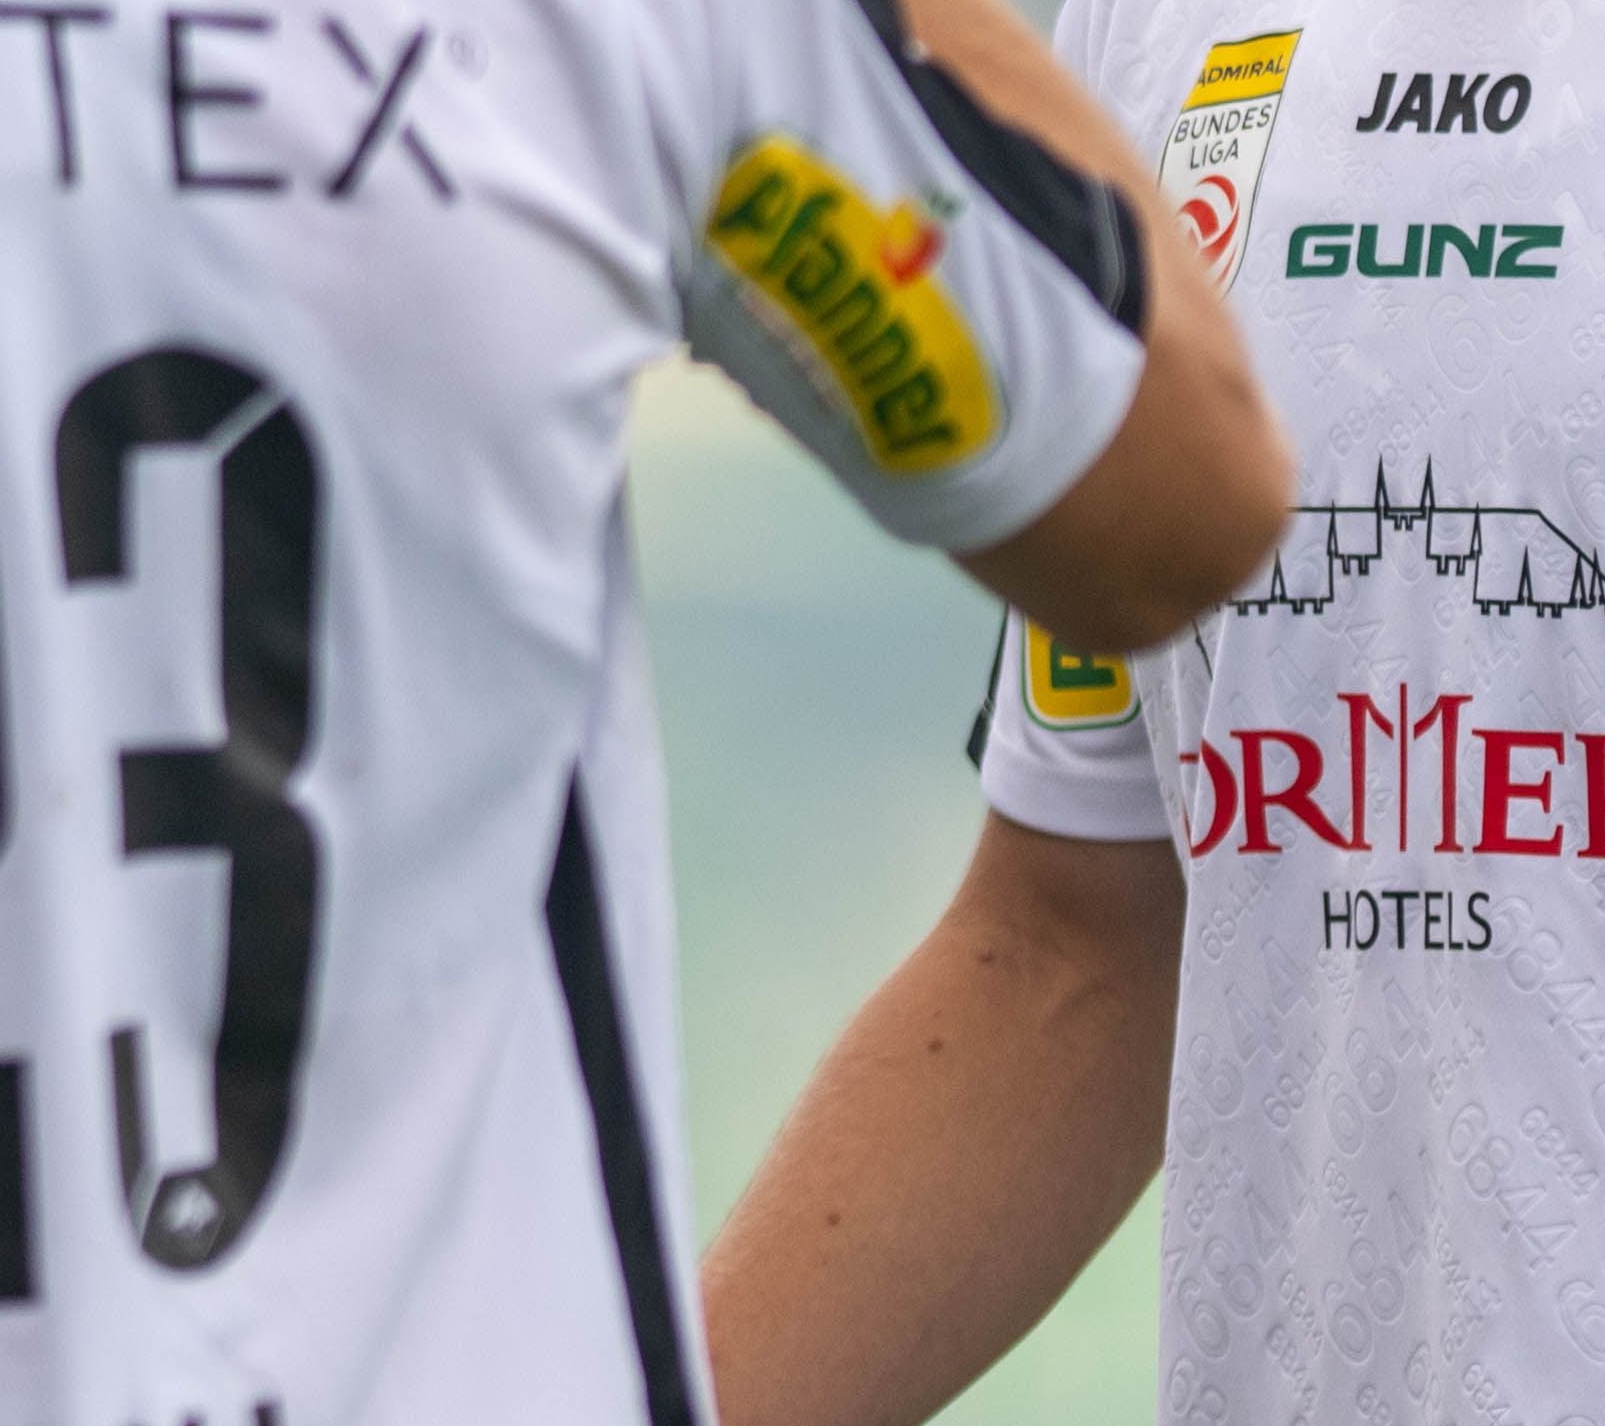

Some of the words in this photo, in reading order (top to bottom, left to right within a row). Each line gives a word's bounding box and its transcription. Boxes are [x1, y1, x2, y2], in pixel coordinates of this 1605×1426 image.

[1196, 53, 1286, 87] ADMIRAL
[1173, 103, 1273, 144] BUNDES
[1355, 72, 1532, 134] JAKO
[1189, 142, 1241, 171] LIGA
[1285, 223, 1565, 279] GUNZ
[1322, 889, 1493, 952] HOTELS
